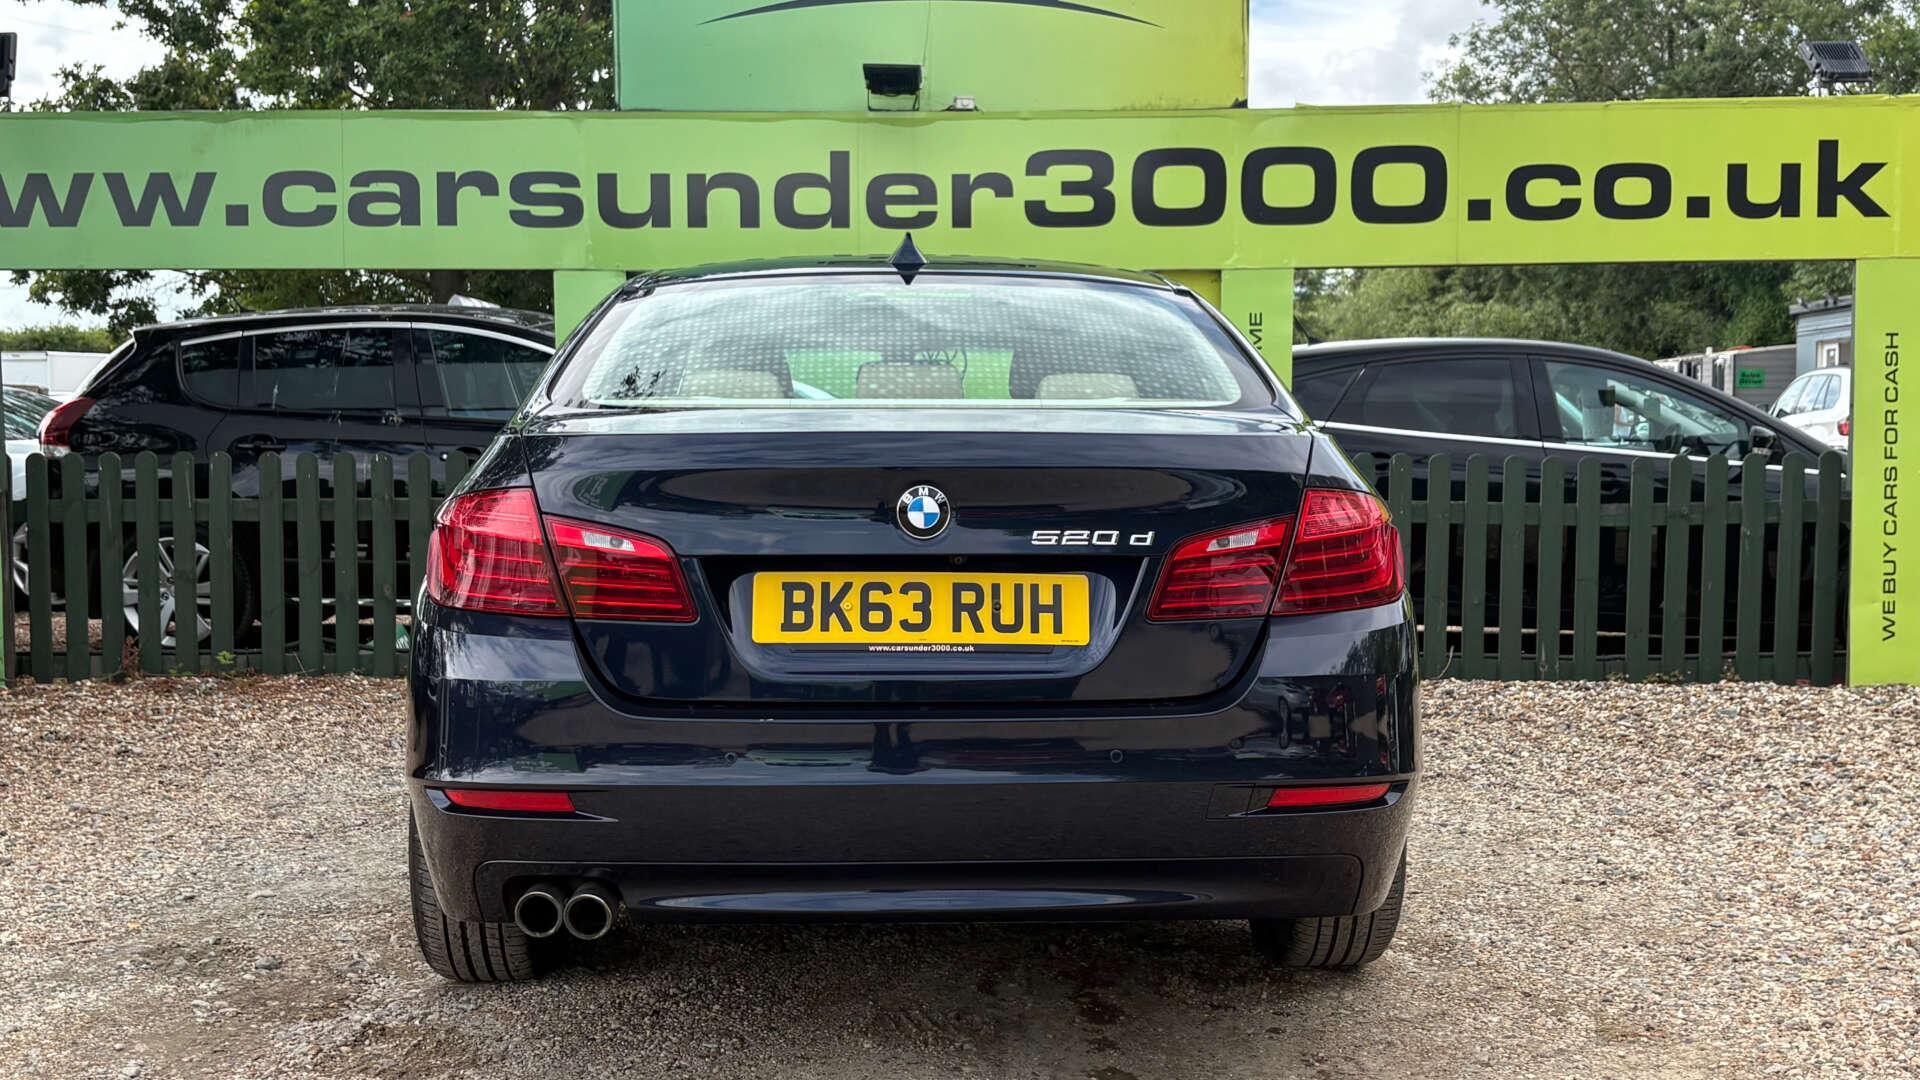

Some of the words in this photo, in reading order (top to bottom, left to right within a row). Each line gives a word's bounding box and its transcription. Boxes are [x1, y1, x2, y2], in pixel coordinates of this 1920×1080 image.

[1884, 332, 1899, 403] CASH
[1884, 409, 1899, 460] FOR
[902, 487, 946, 505] BMW
[1883, 466, 1898, 536] CARS
[1031, 529, 1121, 546] 520
[1129, 530, 1156, 546] d
[1883, 542, 1897, 594] BUY
[780, 581, 932, 634] BK63
[951, 582, 1063, 635] RUH
[1882, 600, 1897, 642] WE
[868, 644, 975, 653] www.carsunder3000.co.uk
